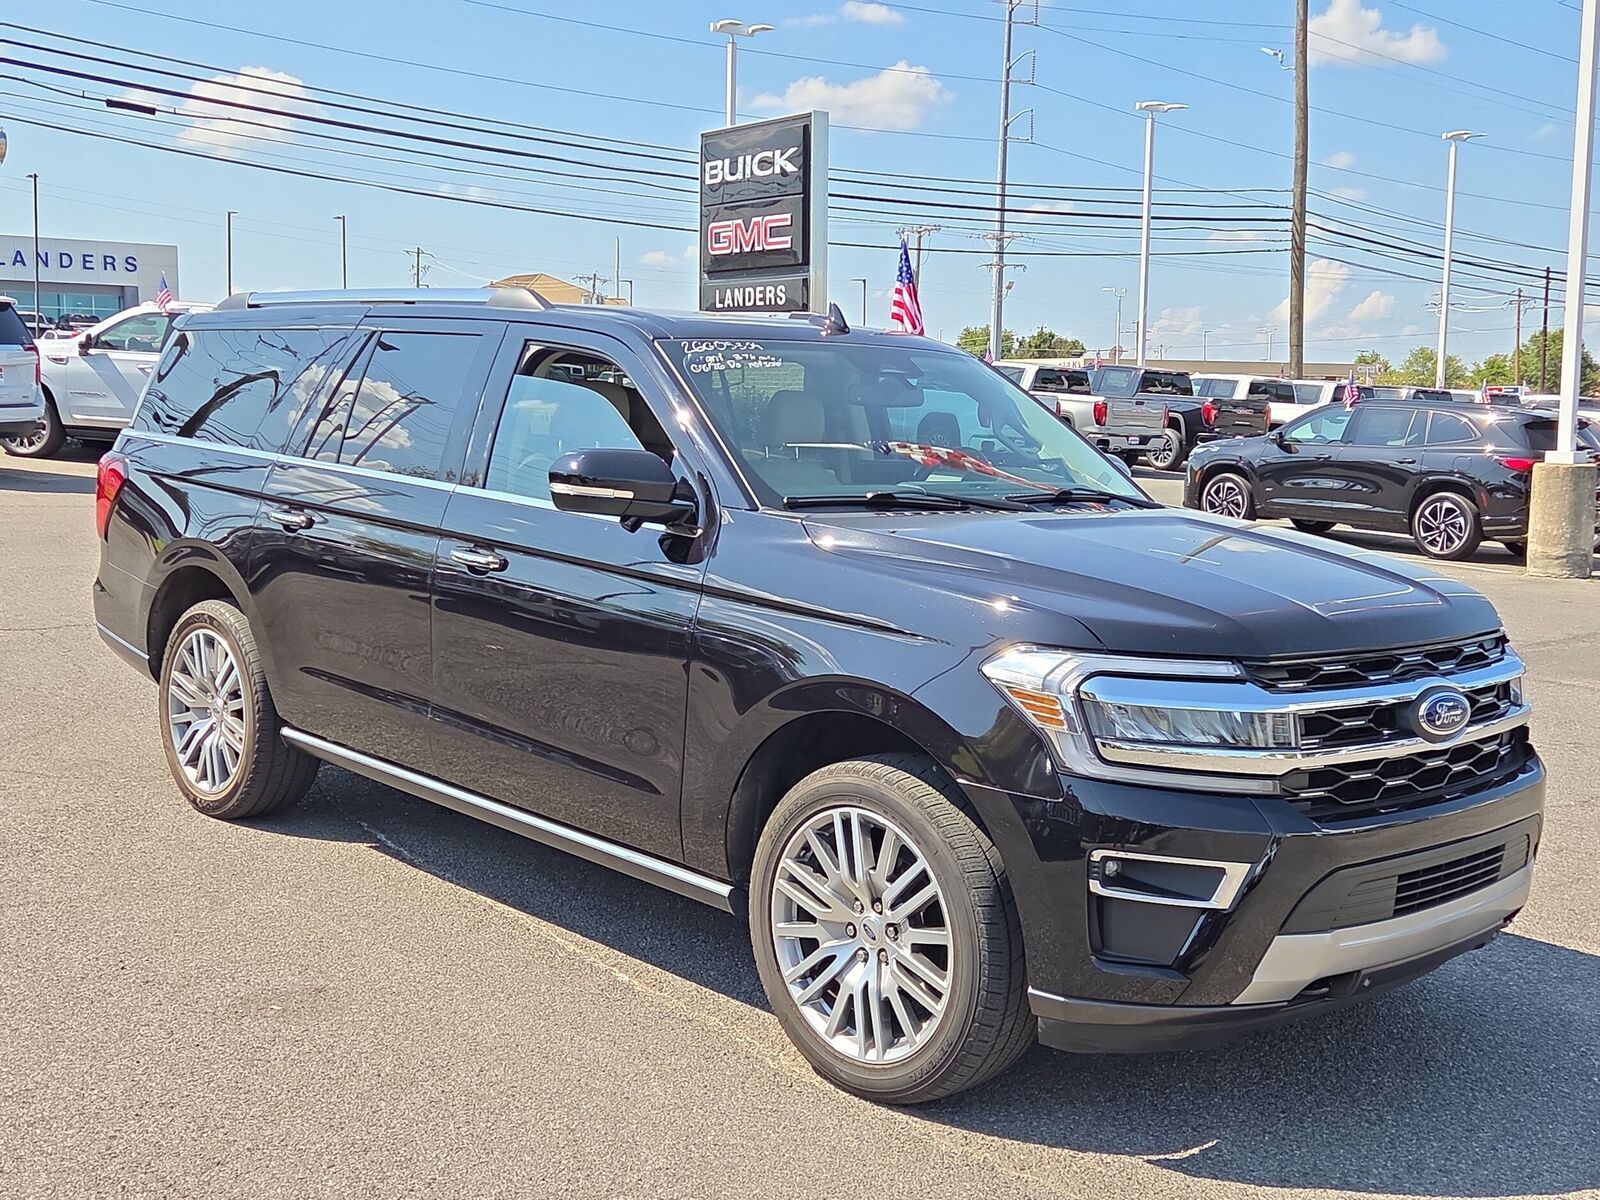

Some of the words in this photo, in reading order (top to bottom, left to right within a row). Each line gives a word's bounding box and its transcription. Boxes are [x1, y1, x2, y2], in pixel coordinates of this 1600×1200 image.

[704, 146, 799, 185] BUICK
[708, 213, 792, 255] GMC
[715, 285, 786, 309] LANDERS
[1436, 702, 1463, 725] Ford
